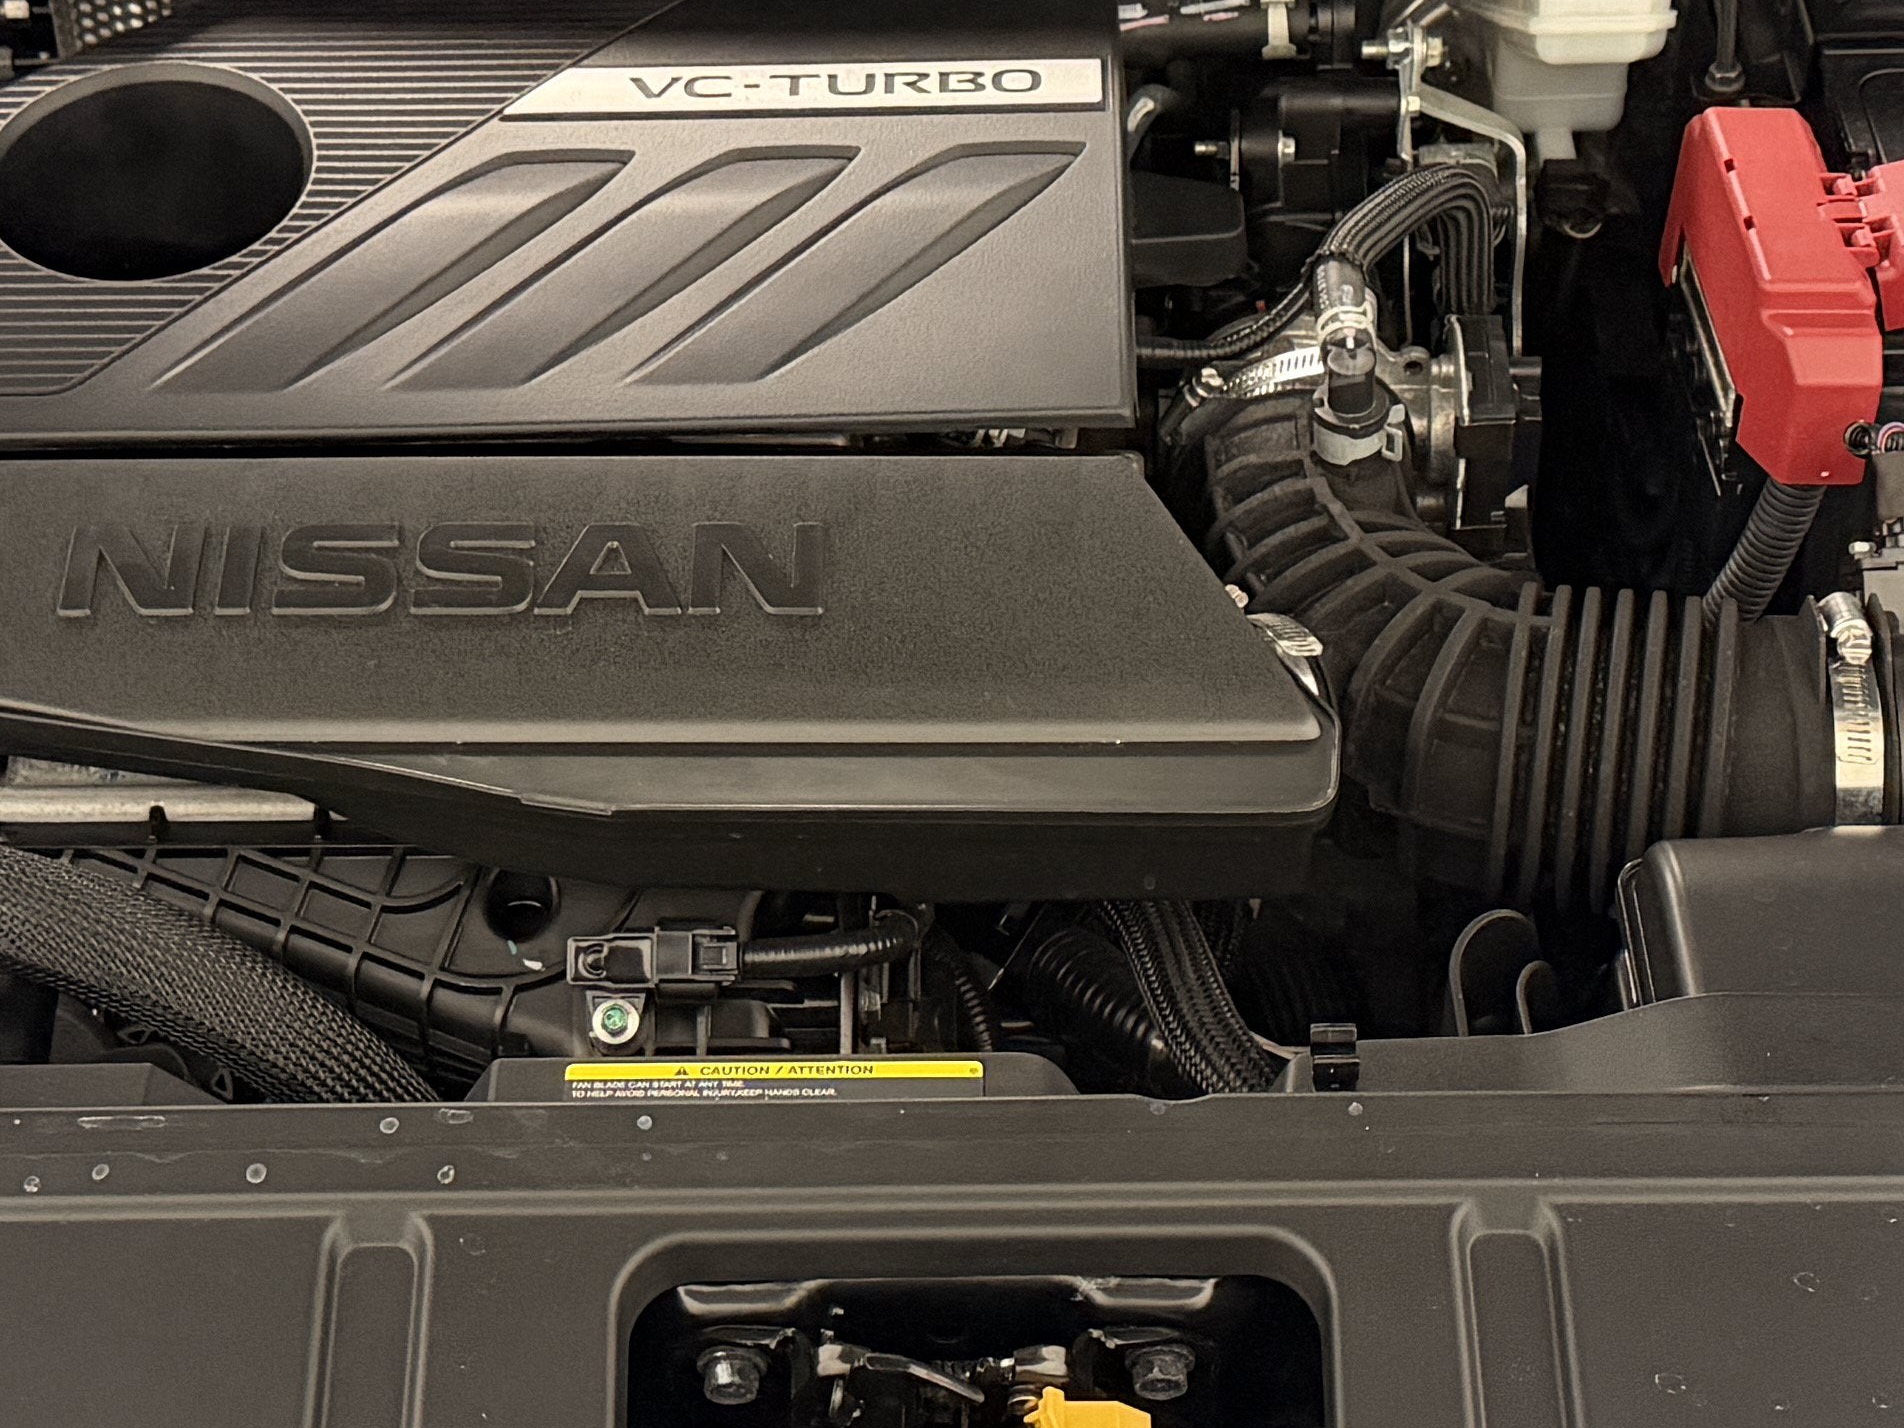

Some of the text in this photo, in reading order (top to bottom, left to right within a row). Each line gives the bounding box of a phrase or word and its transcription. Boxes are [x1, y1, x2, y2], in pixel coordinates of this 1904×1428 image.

[630, 68, 1043, 99] VC-TURBO
[55, 521, 826, 617] NISSAN
[699, 1065, 770, 1076] CAUTION
[787, 1065, 874, 1076] ATTENTION
